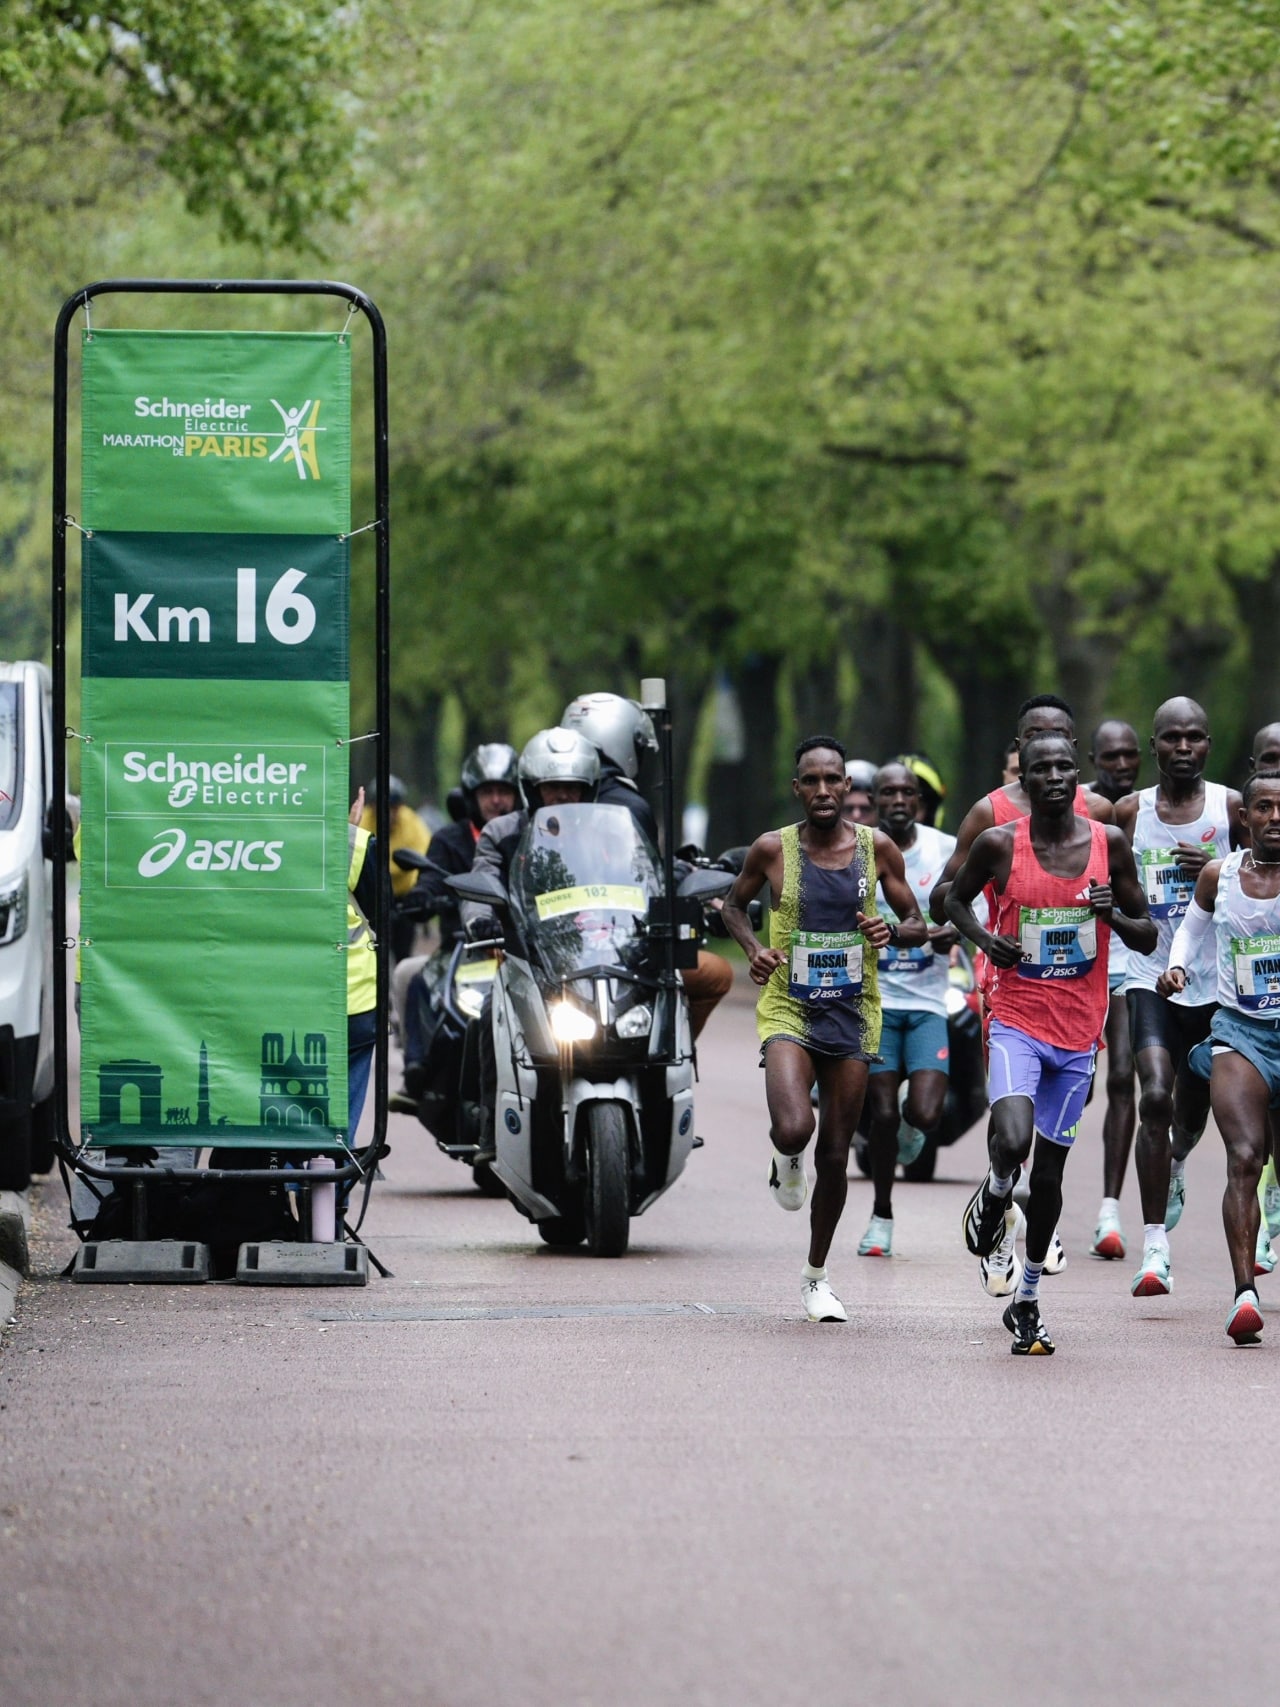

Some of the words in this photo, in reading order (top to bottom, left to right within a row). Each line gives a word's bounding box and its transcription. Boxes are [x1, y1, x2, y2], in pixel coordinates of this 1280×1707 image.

[134, 396, 251, 419] Schneider
[184, 418, 249, 432] Electric
[103, 434, 184, 448] MARATHON
[172, 447, 184, 457] DE
[185, 436, 268, 458] PARIS
[114, 592, 211, 643] Km
[236, 567, 317, 645] 16
[122, 751, 307, 785] Schneider
[202, 785, 303, 806] Electric
[583, 886, 608, 898] 102
[1149, 894, 1157, 904] 16
[1041, 908, 1090, 919] Schneider
[810, 932, 857, 944] Schneider
[1045, 930, 1076, 946] KROP
[793, 972, 798, 983] 9
